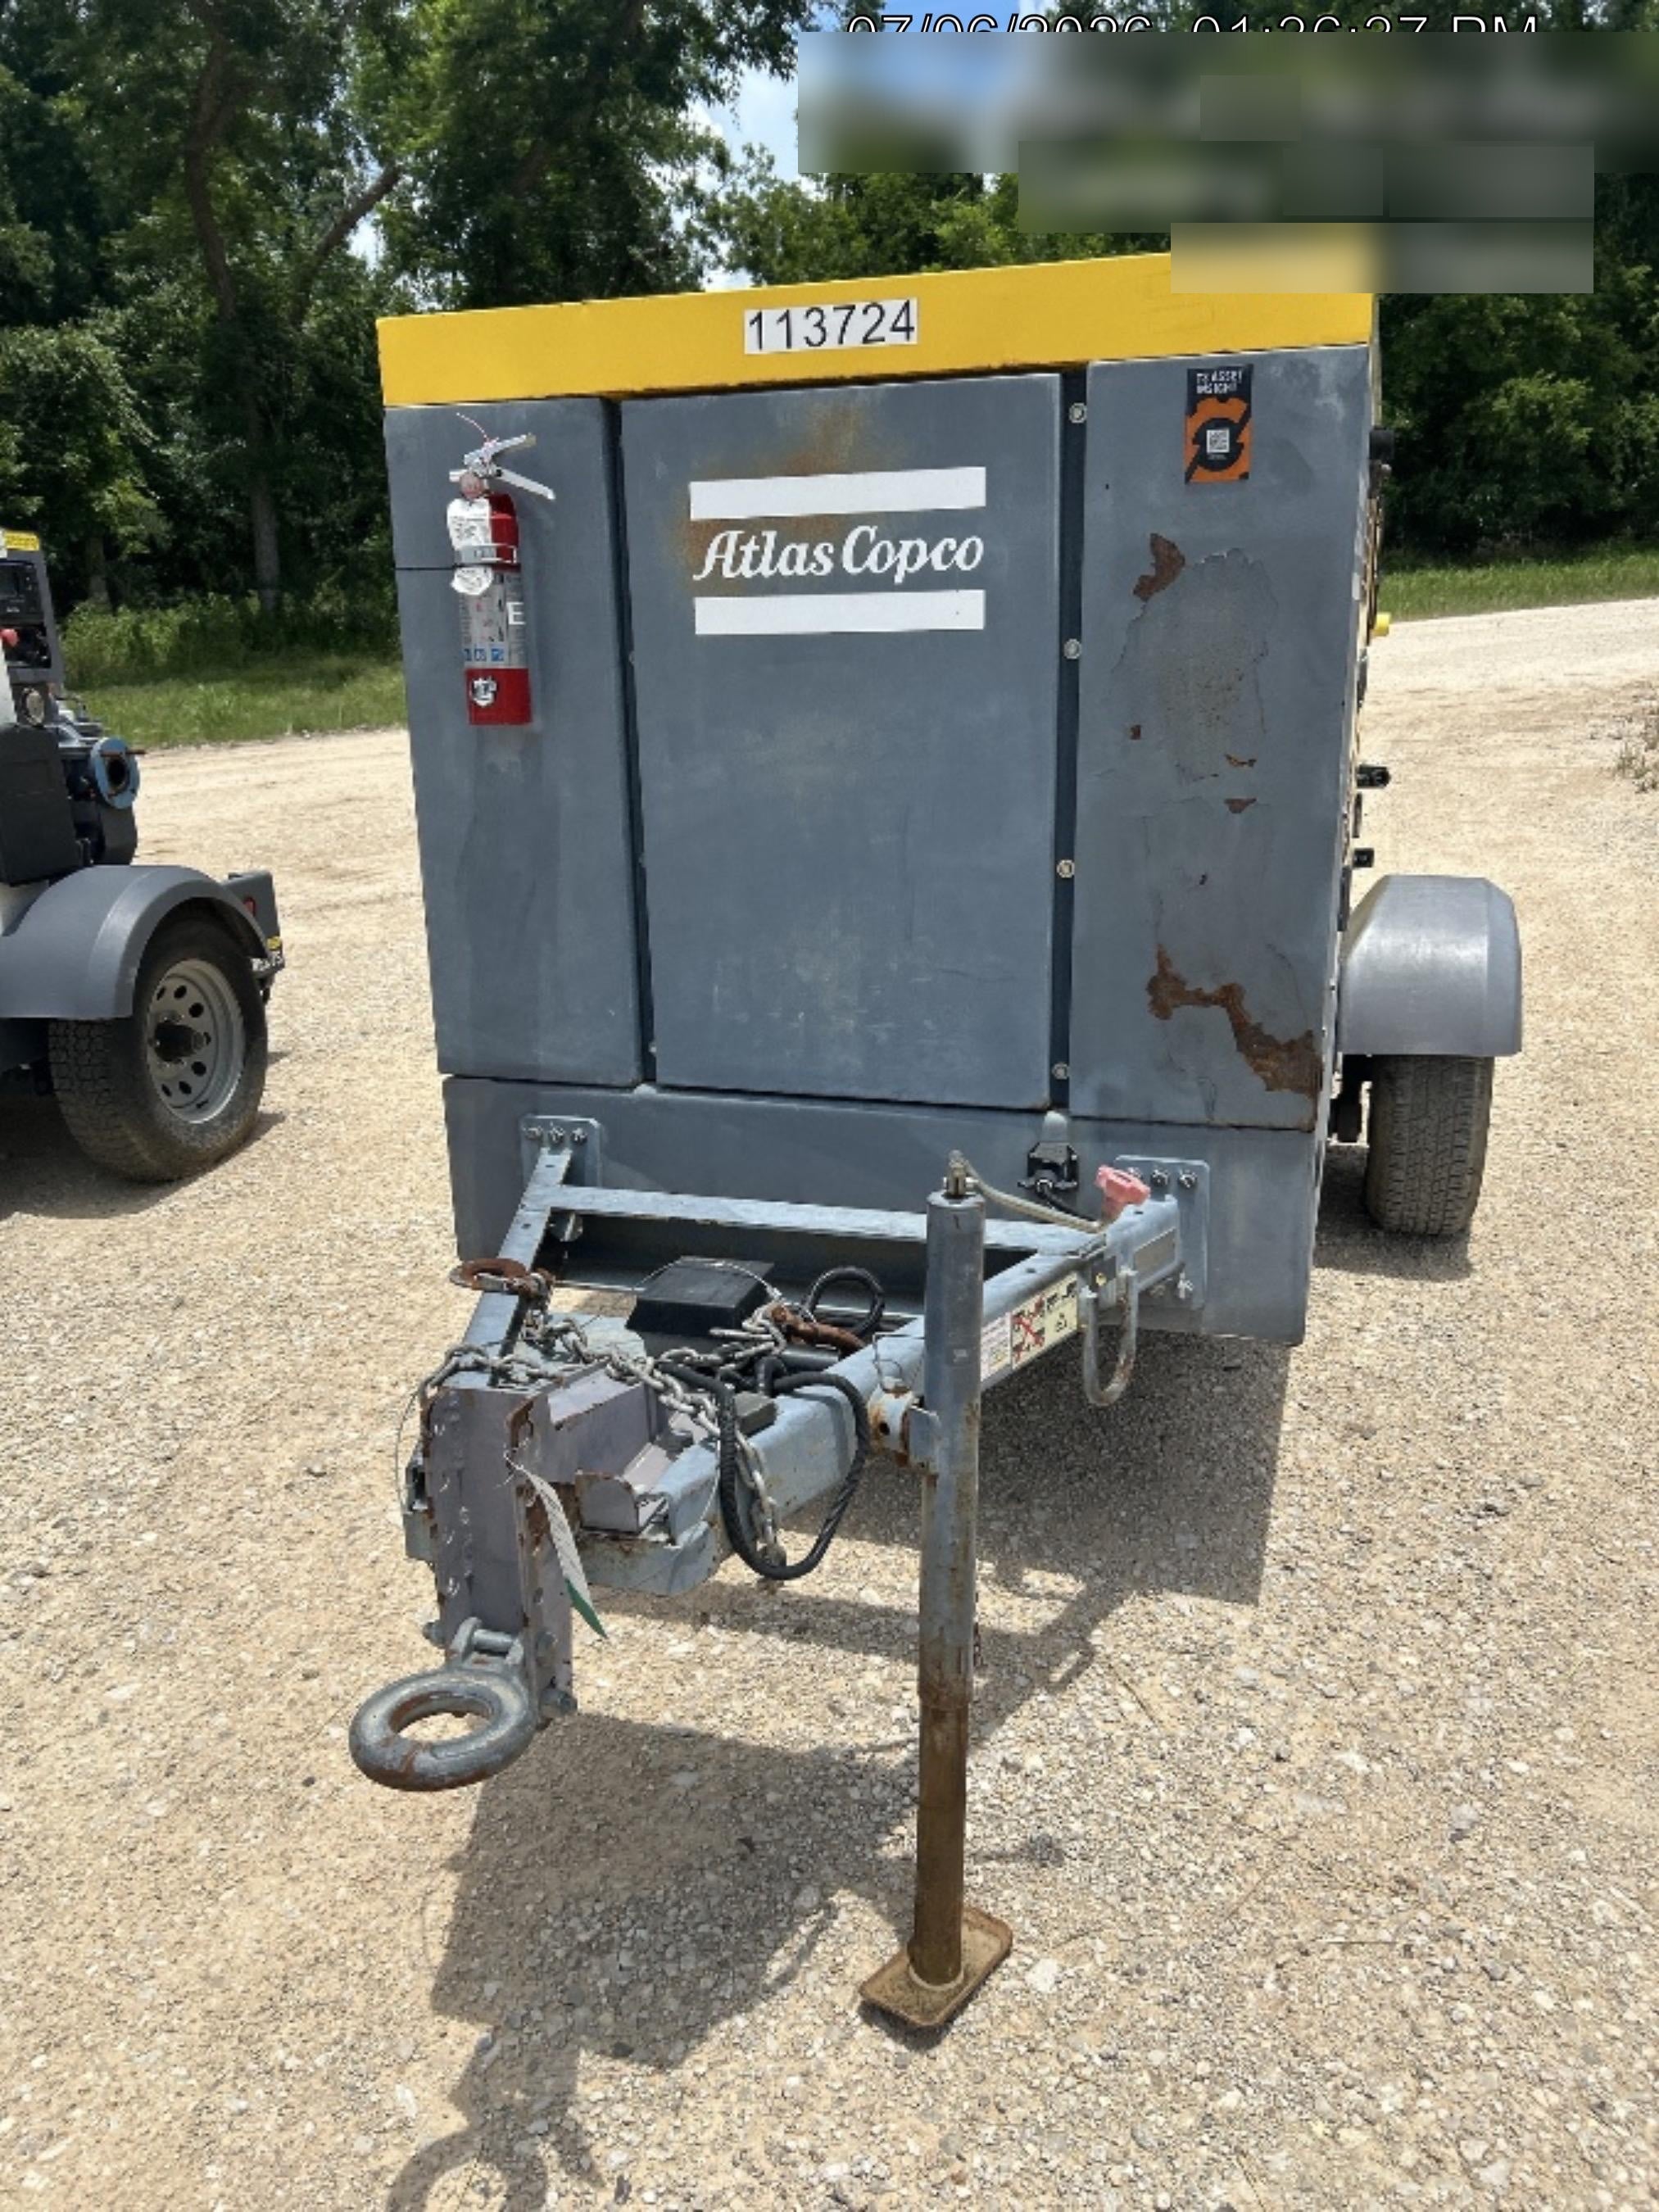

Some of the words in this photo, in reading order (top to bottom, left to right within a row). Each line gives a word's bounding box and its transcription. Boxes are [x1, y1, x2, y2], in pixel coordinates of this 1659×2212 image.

[749, 299, 915, 351] 113724
[692, 530, 834, 581] Atlas
[841, 525, 983, 585] Copco
